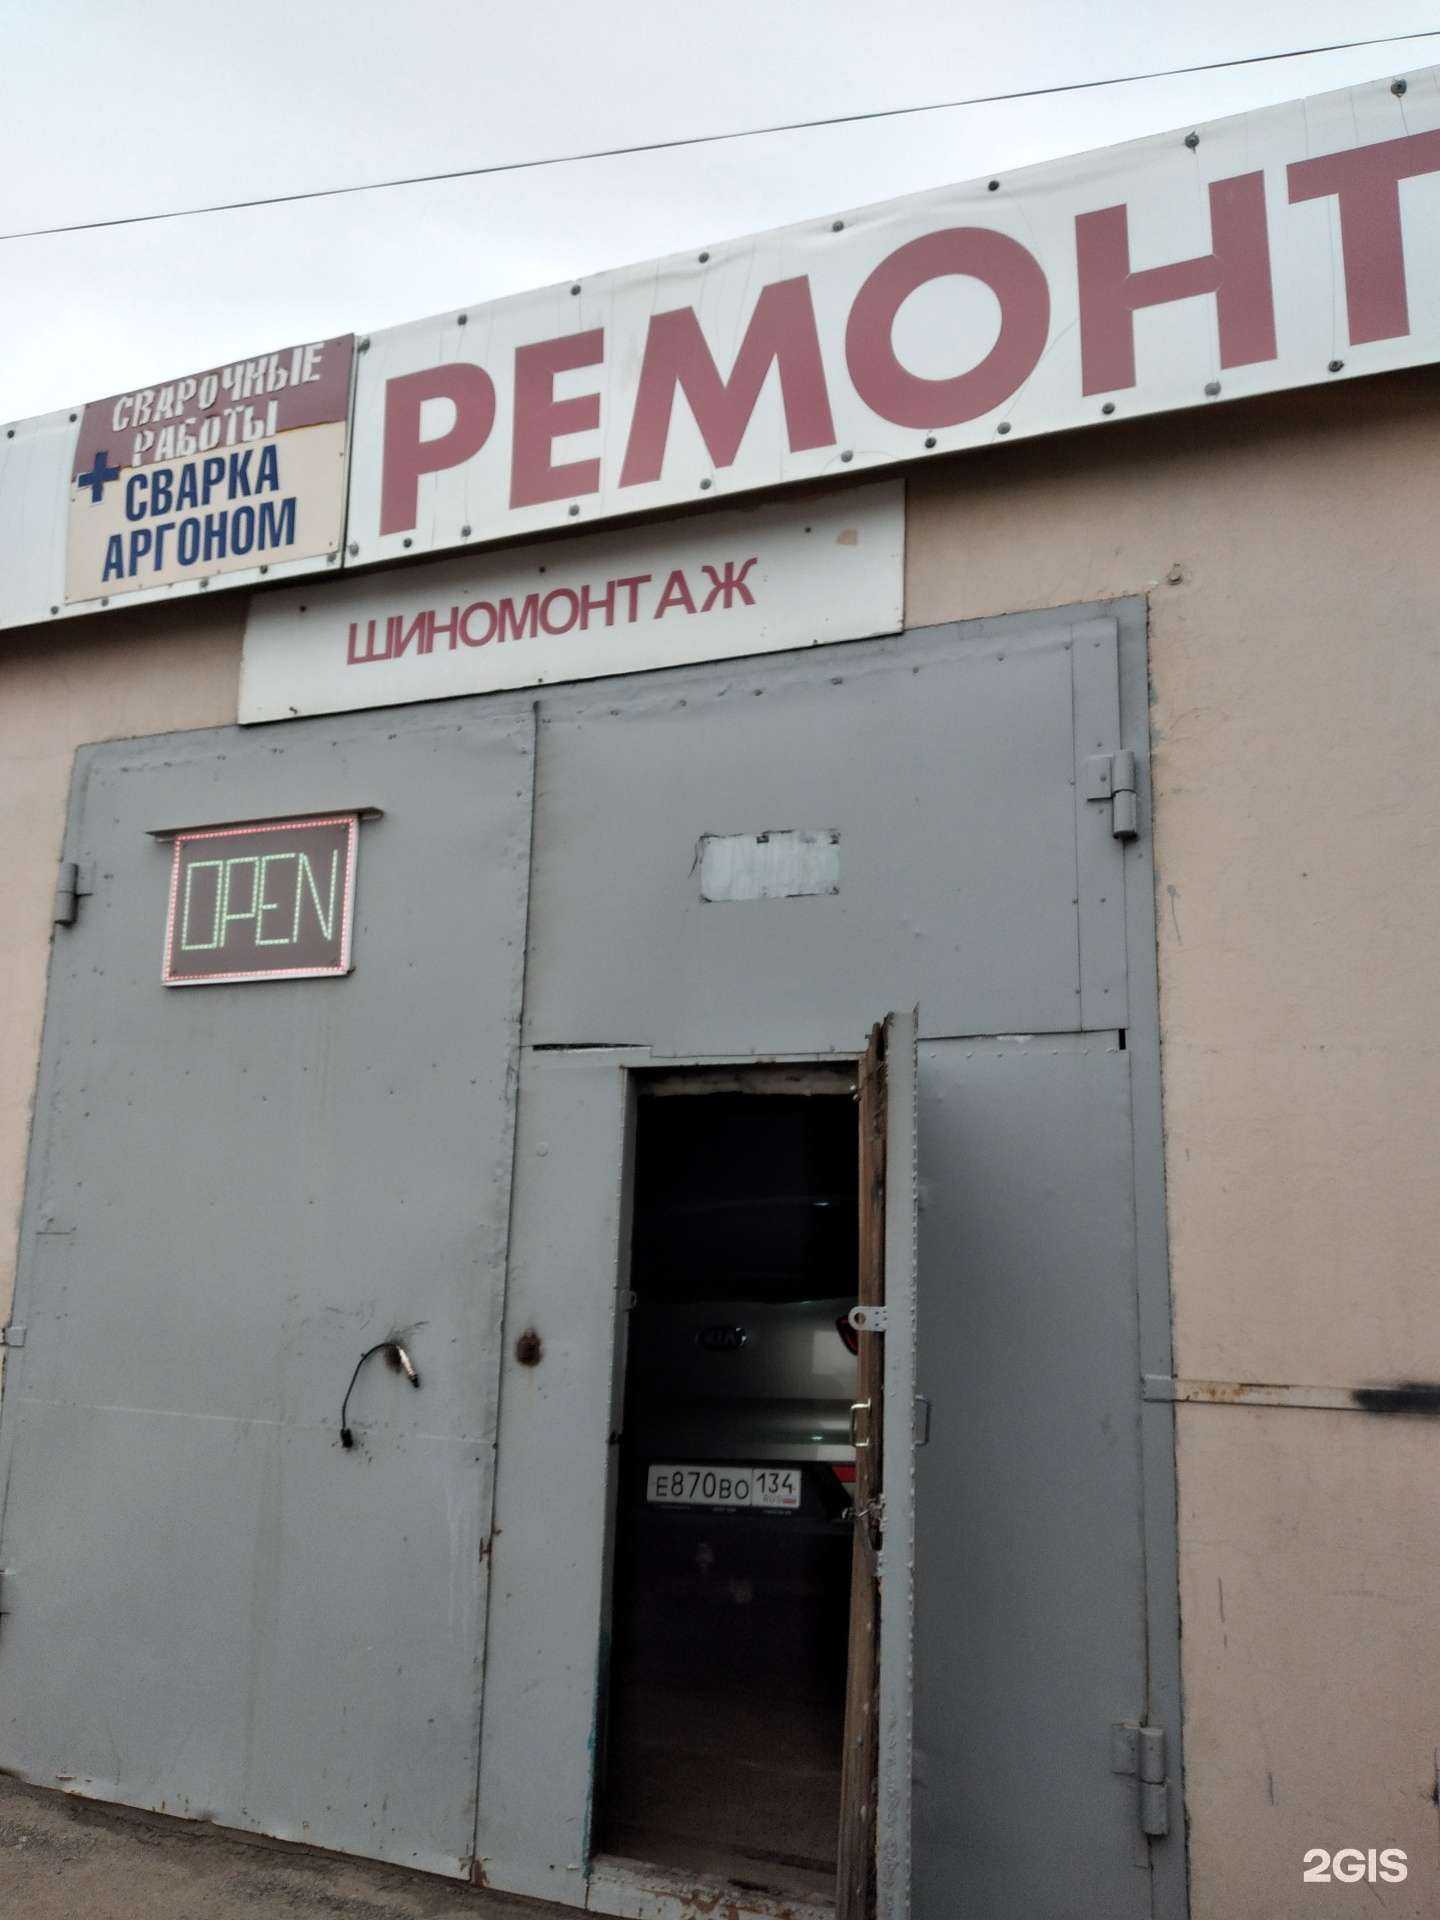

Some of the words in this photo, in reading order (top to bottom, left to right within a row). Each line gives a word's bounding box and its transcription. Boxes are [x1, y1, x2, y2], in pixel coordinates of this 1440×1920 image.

[380, 129, 1440, 535] РЕМОНТ
[112, 343, 324, 432] СВАРОЧНЫЕ
[131, 400, 278, 468] РАБОТЫ
[125, 444, 279, 521] СВАРКА
[102, 497, 297, 582] АРГОНОМ
[347, 557, 758, 665] ШИНОМОНТАЖ
[181, 848, 338, 951] OPEN
[755, 1472, 794, 1494] 134
